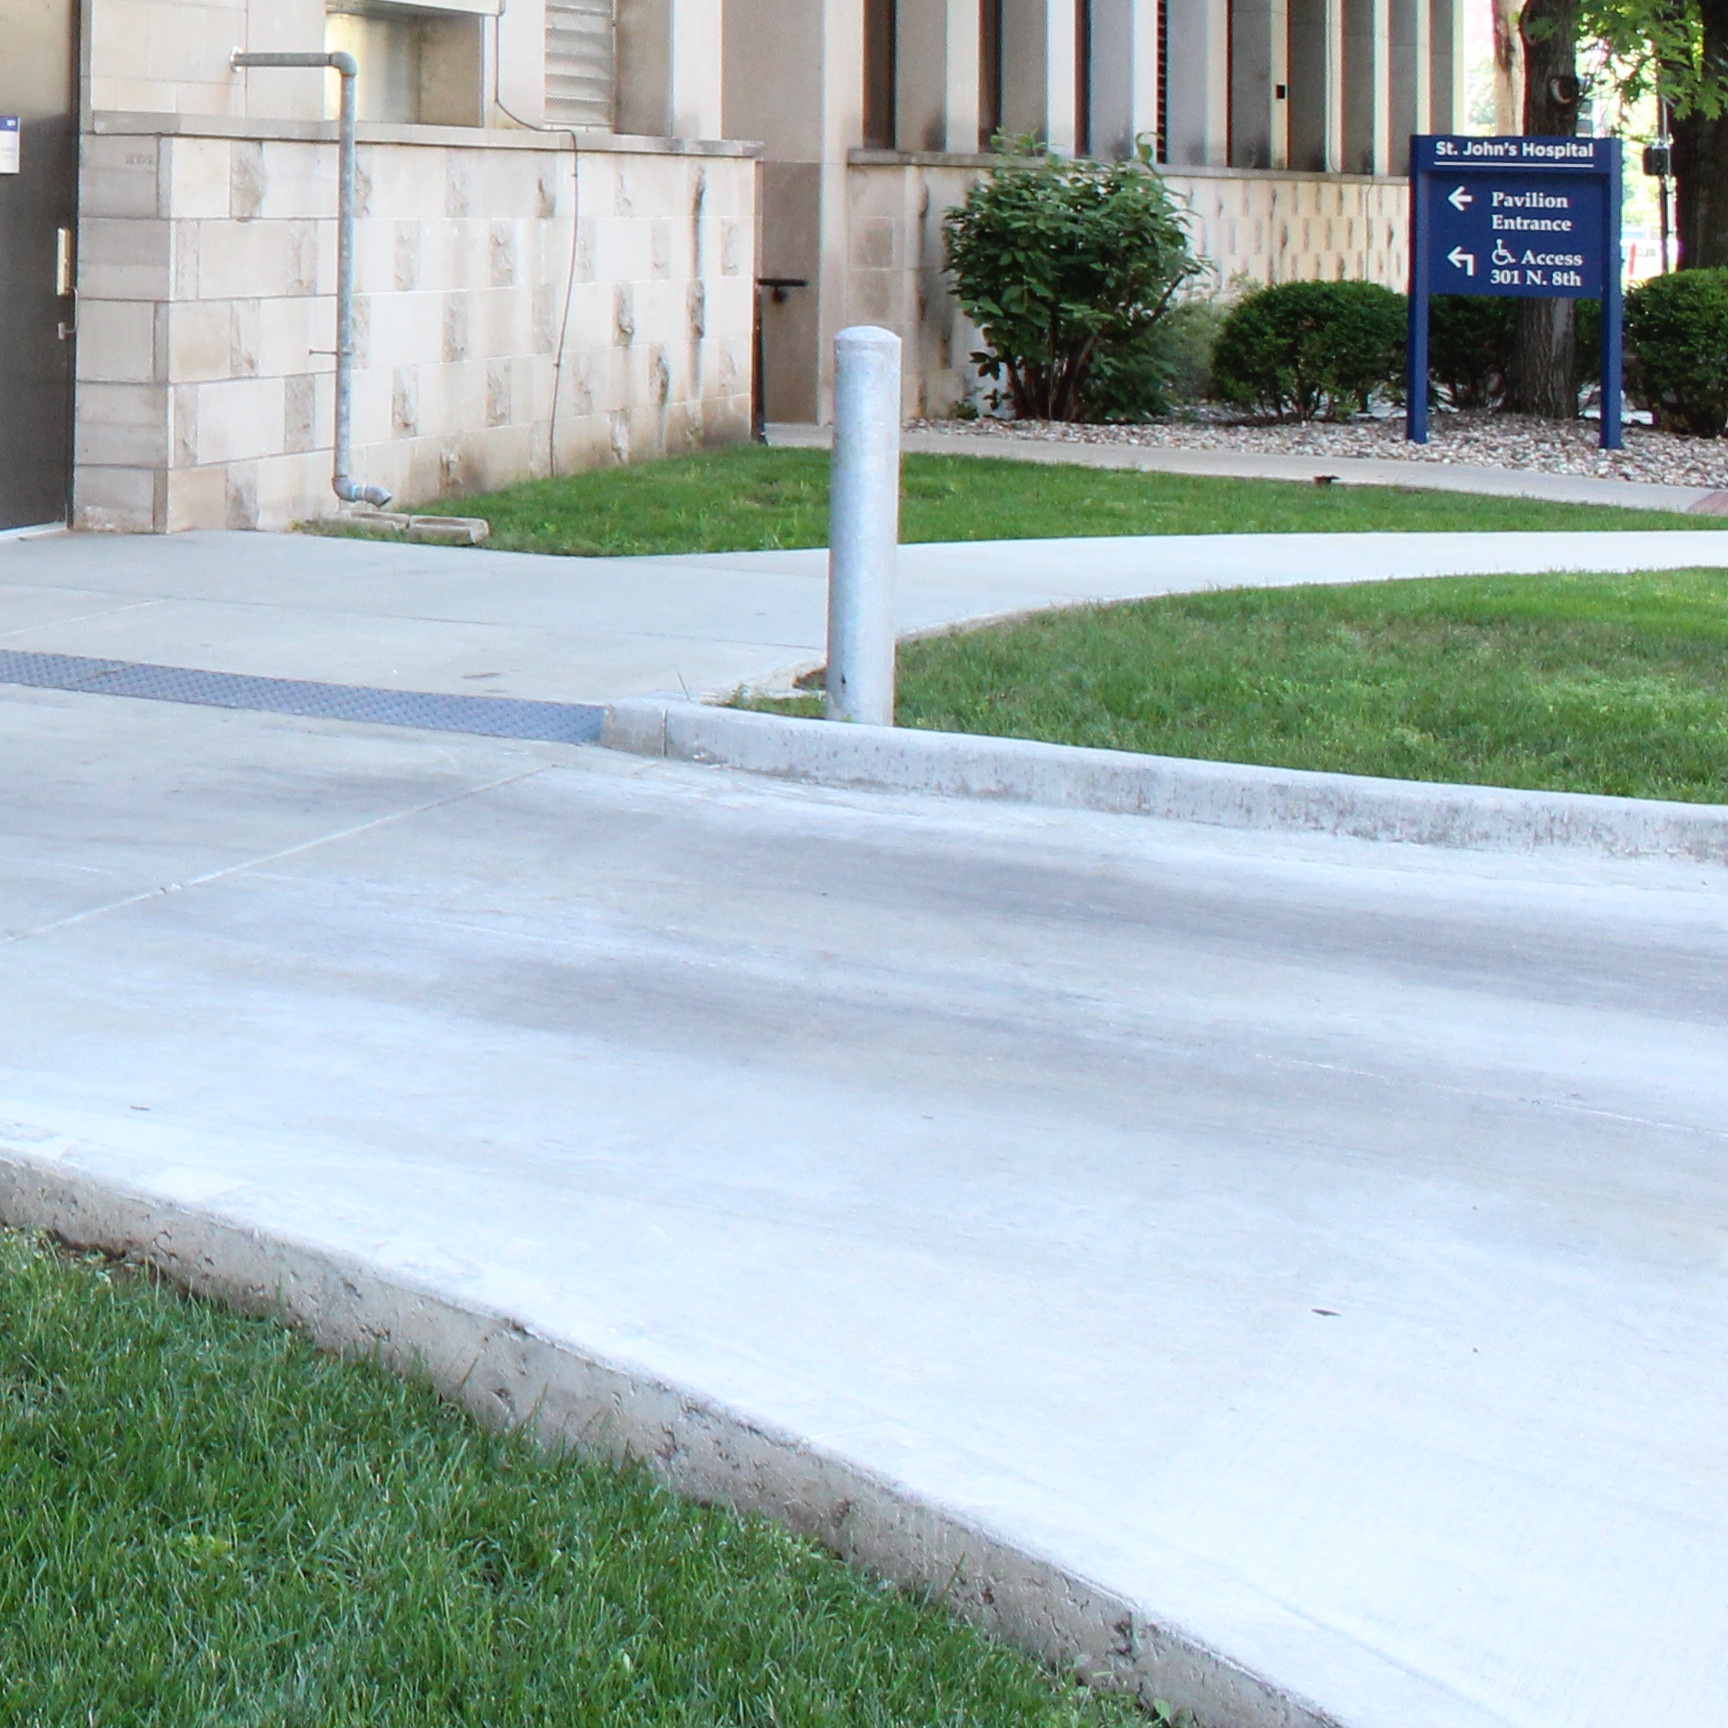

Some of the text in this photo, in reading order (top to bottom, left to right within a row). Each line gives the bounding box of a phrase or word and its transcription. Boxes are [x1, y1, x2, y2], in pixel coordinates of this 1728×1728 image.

[1436, 141, 1593, 159] St. John's Hospital
[1491, 191, 1569, 209] Pavilion
[1491, 214, 1572, 231] Entrance
[1521, 249, 1583, 266] Access
[1490, 270, 1582, 287] 301 N. 8th
